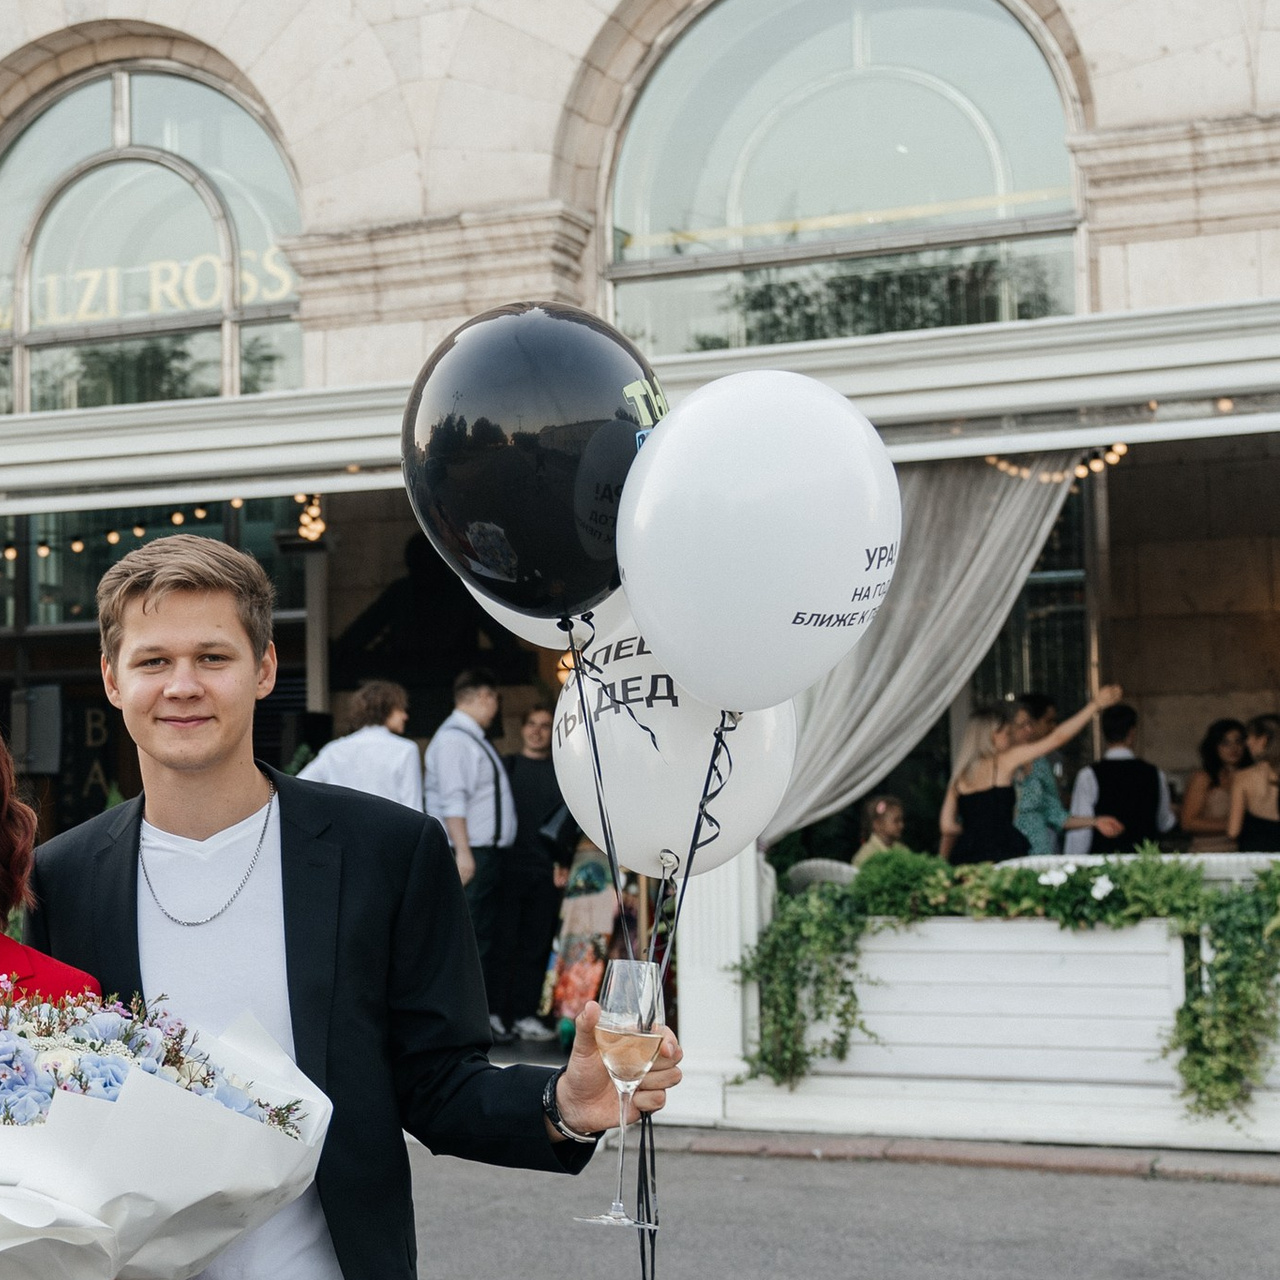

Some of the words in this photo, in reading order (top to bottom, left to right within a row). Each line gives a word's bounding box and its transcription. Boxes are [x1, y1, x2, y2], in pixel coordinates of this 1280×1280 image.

[864, 541, 898, 572] УРА!
[851, 586, 871, 602] НА
[791, 611, 860, 628] БЛИЖЕ
[593, 674, 679, 723] ДЕД
